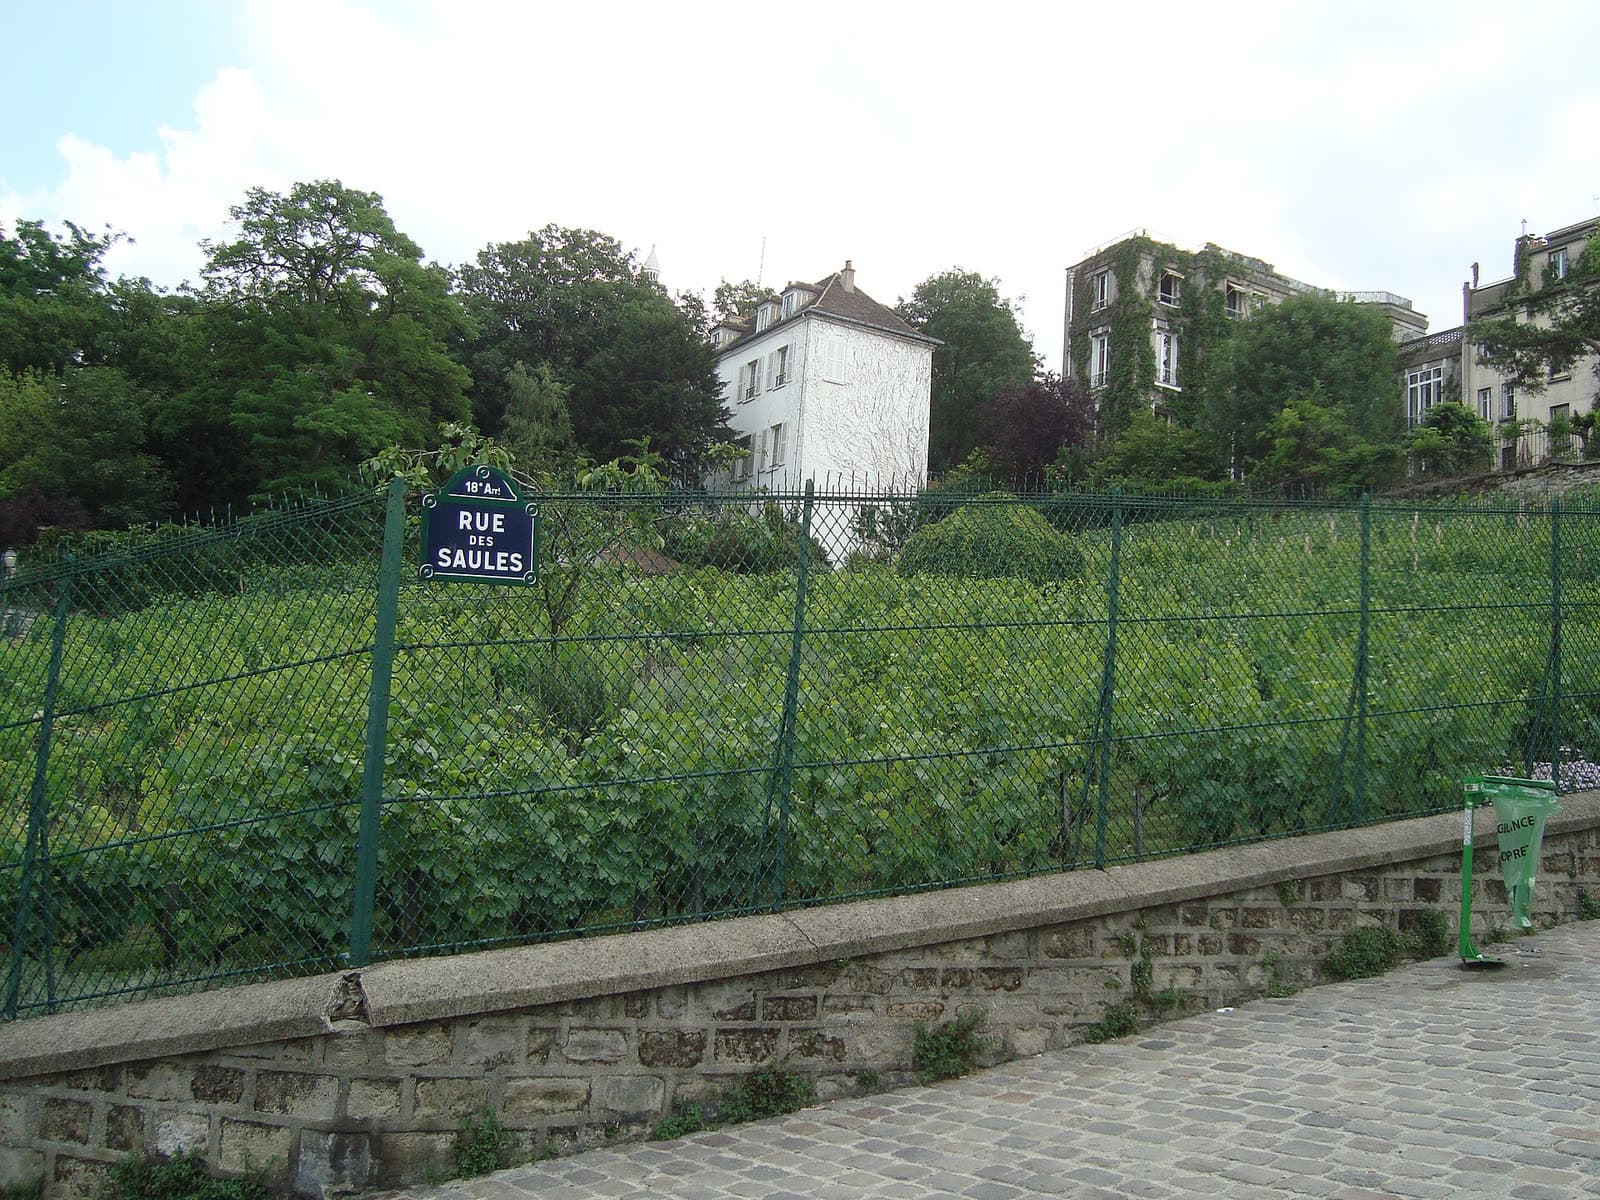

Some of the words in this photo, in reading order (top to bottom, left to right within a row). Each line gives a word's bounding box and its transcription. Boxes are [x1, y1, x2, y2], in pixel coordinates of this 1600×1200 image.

[459, 510, 505, 533] RUE
[469, 535, 494, 547] DES
[438, 548, 523, 572] SAULES
[1497, 816, 1535, 833] GILNCE
